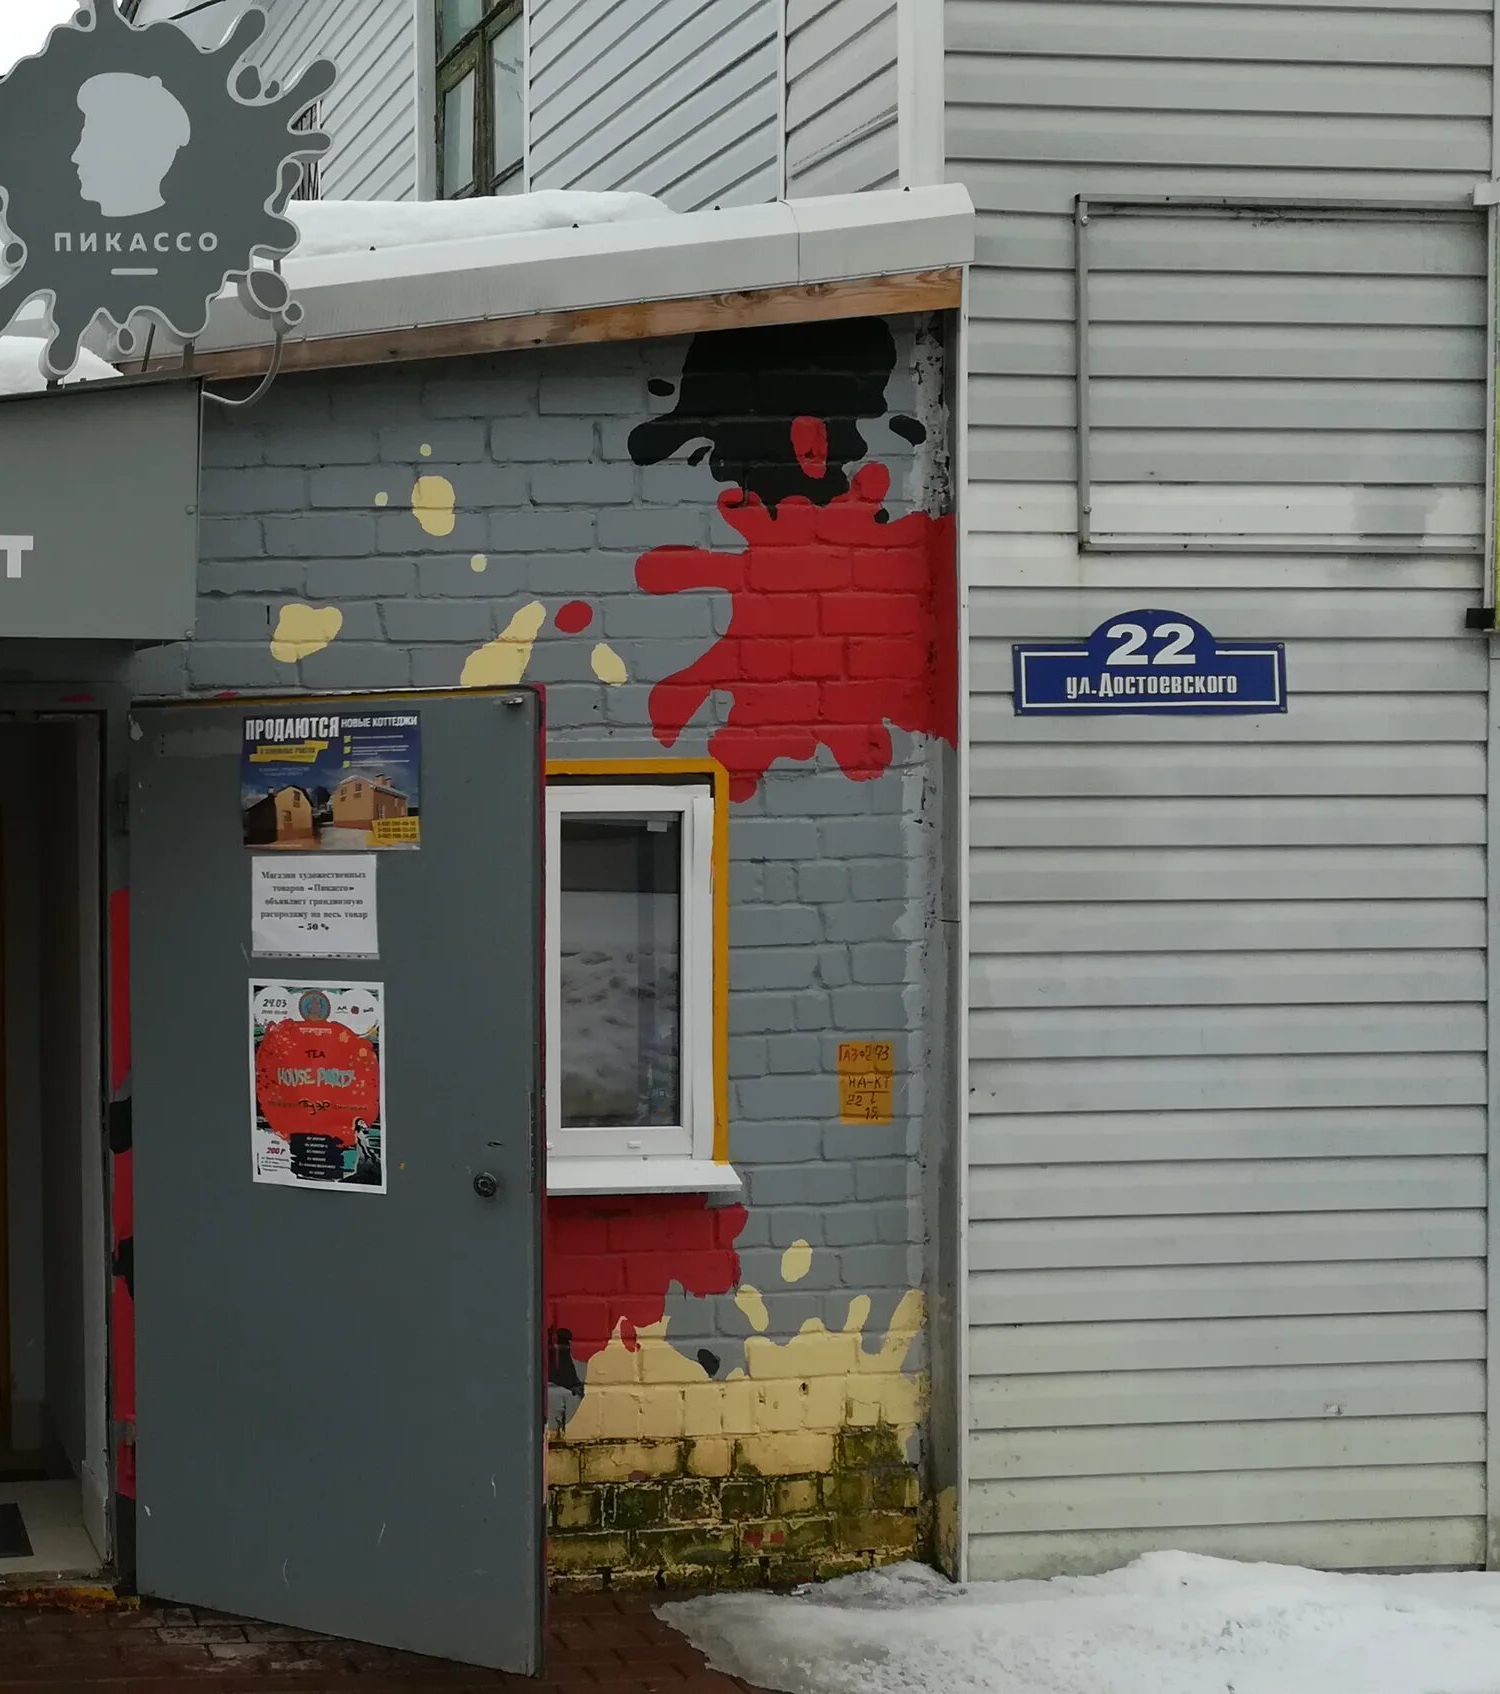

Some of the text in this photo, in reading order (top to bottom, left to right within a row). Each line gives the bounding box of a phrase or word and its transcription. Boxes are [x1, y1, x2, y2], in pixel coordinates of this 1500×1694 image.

[53, 231, 219, 253] ПИКАССО
[1106, 622, 1197, 666] 22
[245, 716, 340, 742] ПРОДАЮТСЯ
[341, 717, 371, 729] НОВЫЕ
[372, 715, 418, 728] КОТТЕДЖИ
[261, 871, 366, 881] Магазин художественных
[273, 885, 305, 894] товаров
[265, 898, 364, 907] объявляет грандиозную
[260, 911, 308, 921] распродажу
[345, 912, 368, 921] товар
